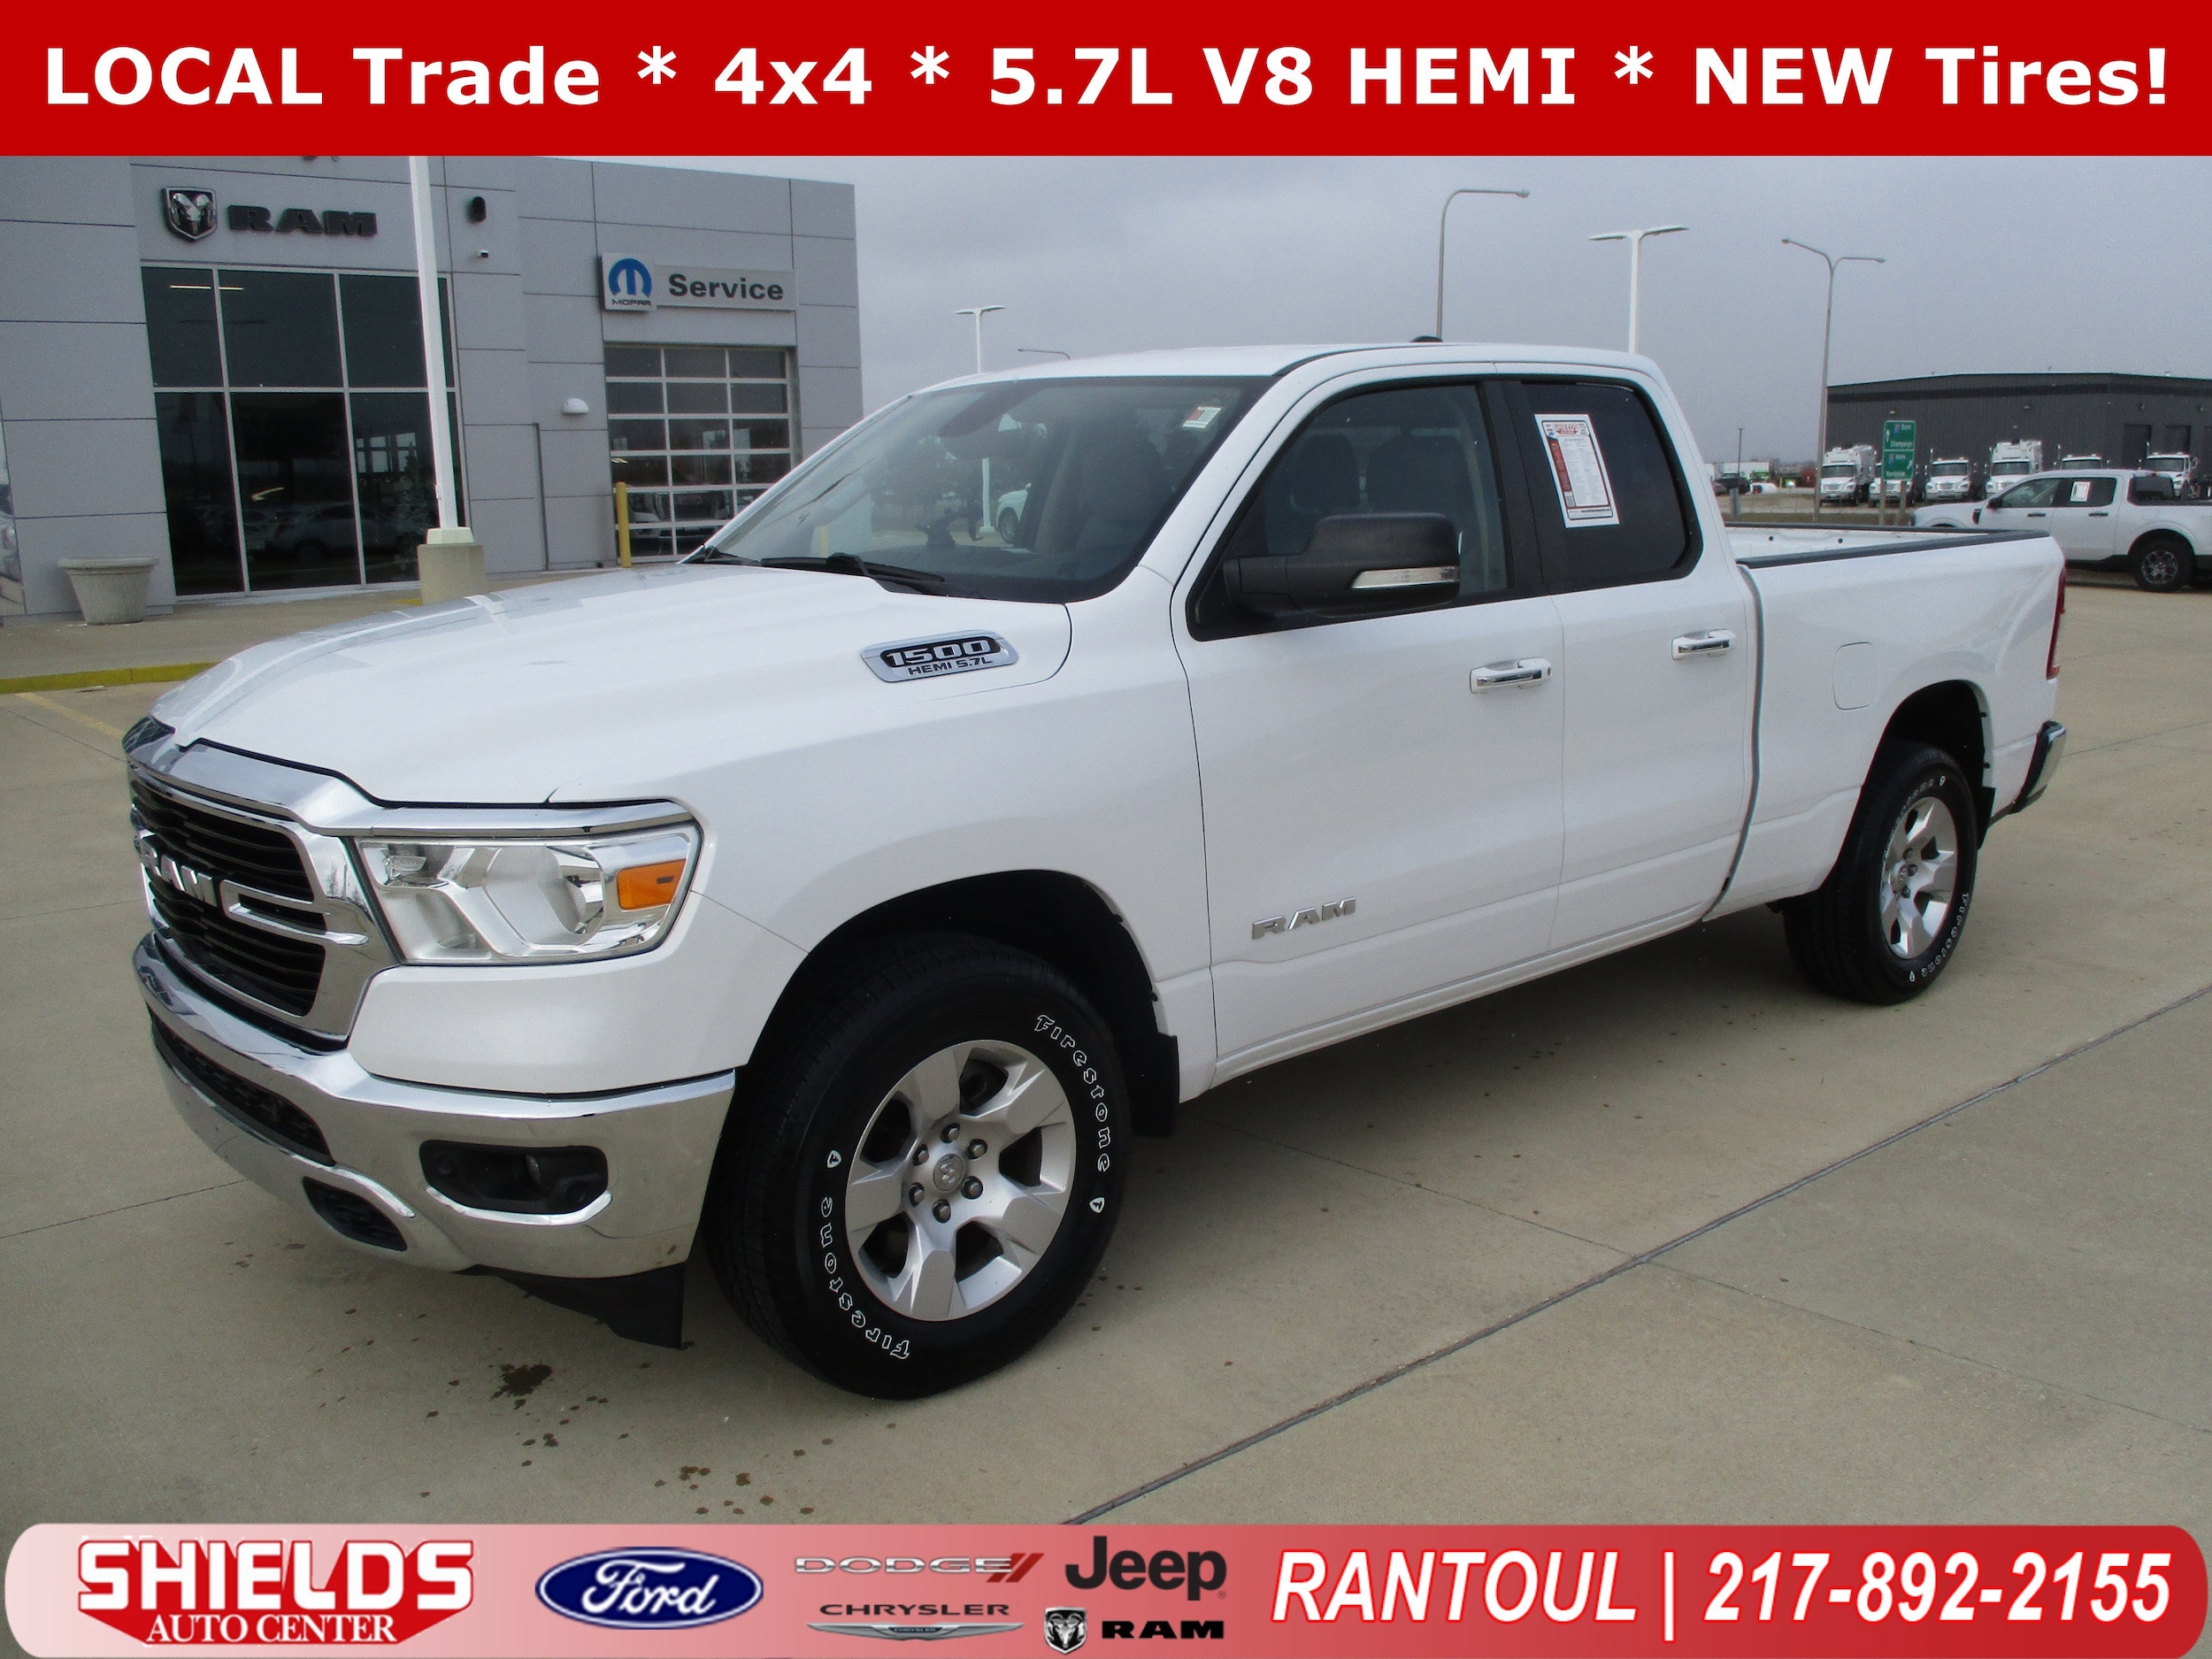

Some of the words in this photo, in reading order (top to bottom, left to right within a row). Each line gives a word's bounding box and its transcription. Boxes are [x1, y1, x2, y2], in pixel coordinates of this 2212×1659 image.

[227, 204, 379, 236] RAM
[611, 297, 652, 307] MOPAR
[668, 273, 784, 302] Service
[886, 639, 992, 667] 1500
[907, 661, 953, 676] HEMI
[956, 657, 994, 670] 5.7L
[140, 833, 219, 908] RAM
[1251, 896, 1356, 941] RAM
[1033, 1014, 1111, 1173] Firestone
[819, 1195, 911, 1361] Firestone
